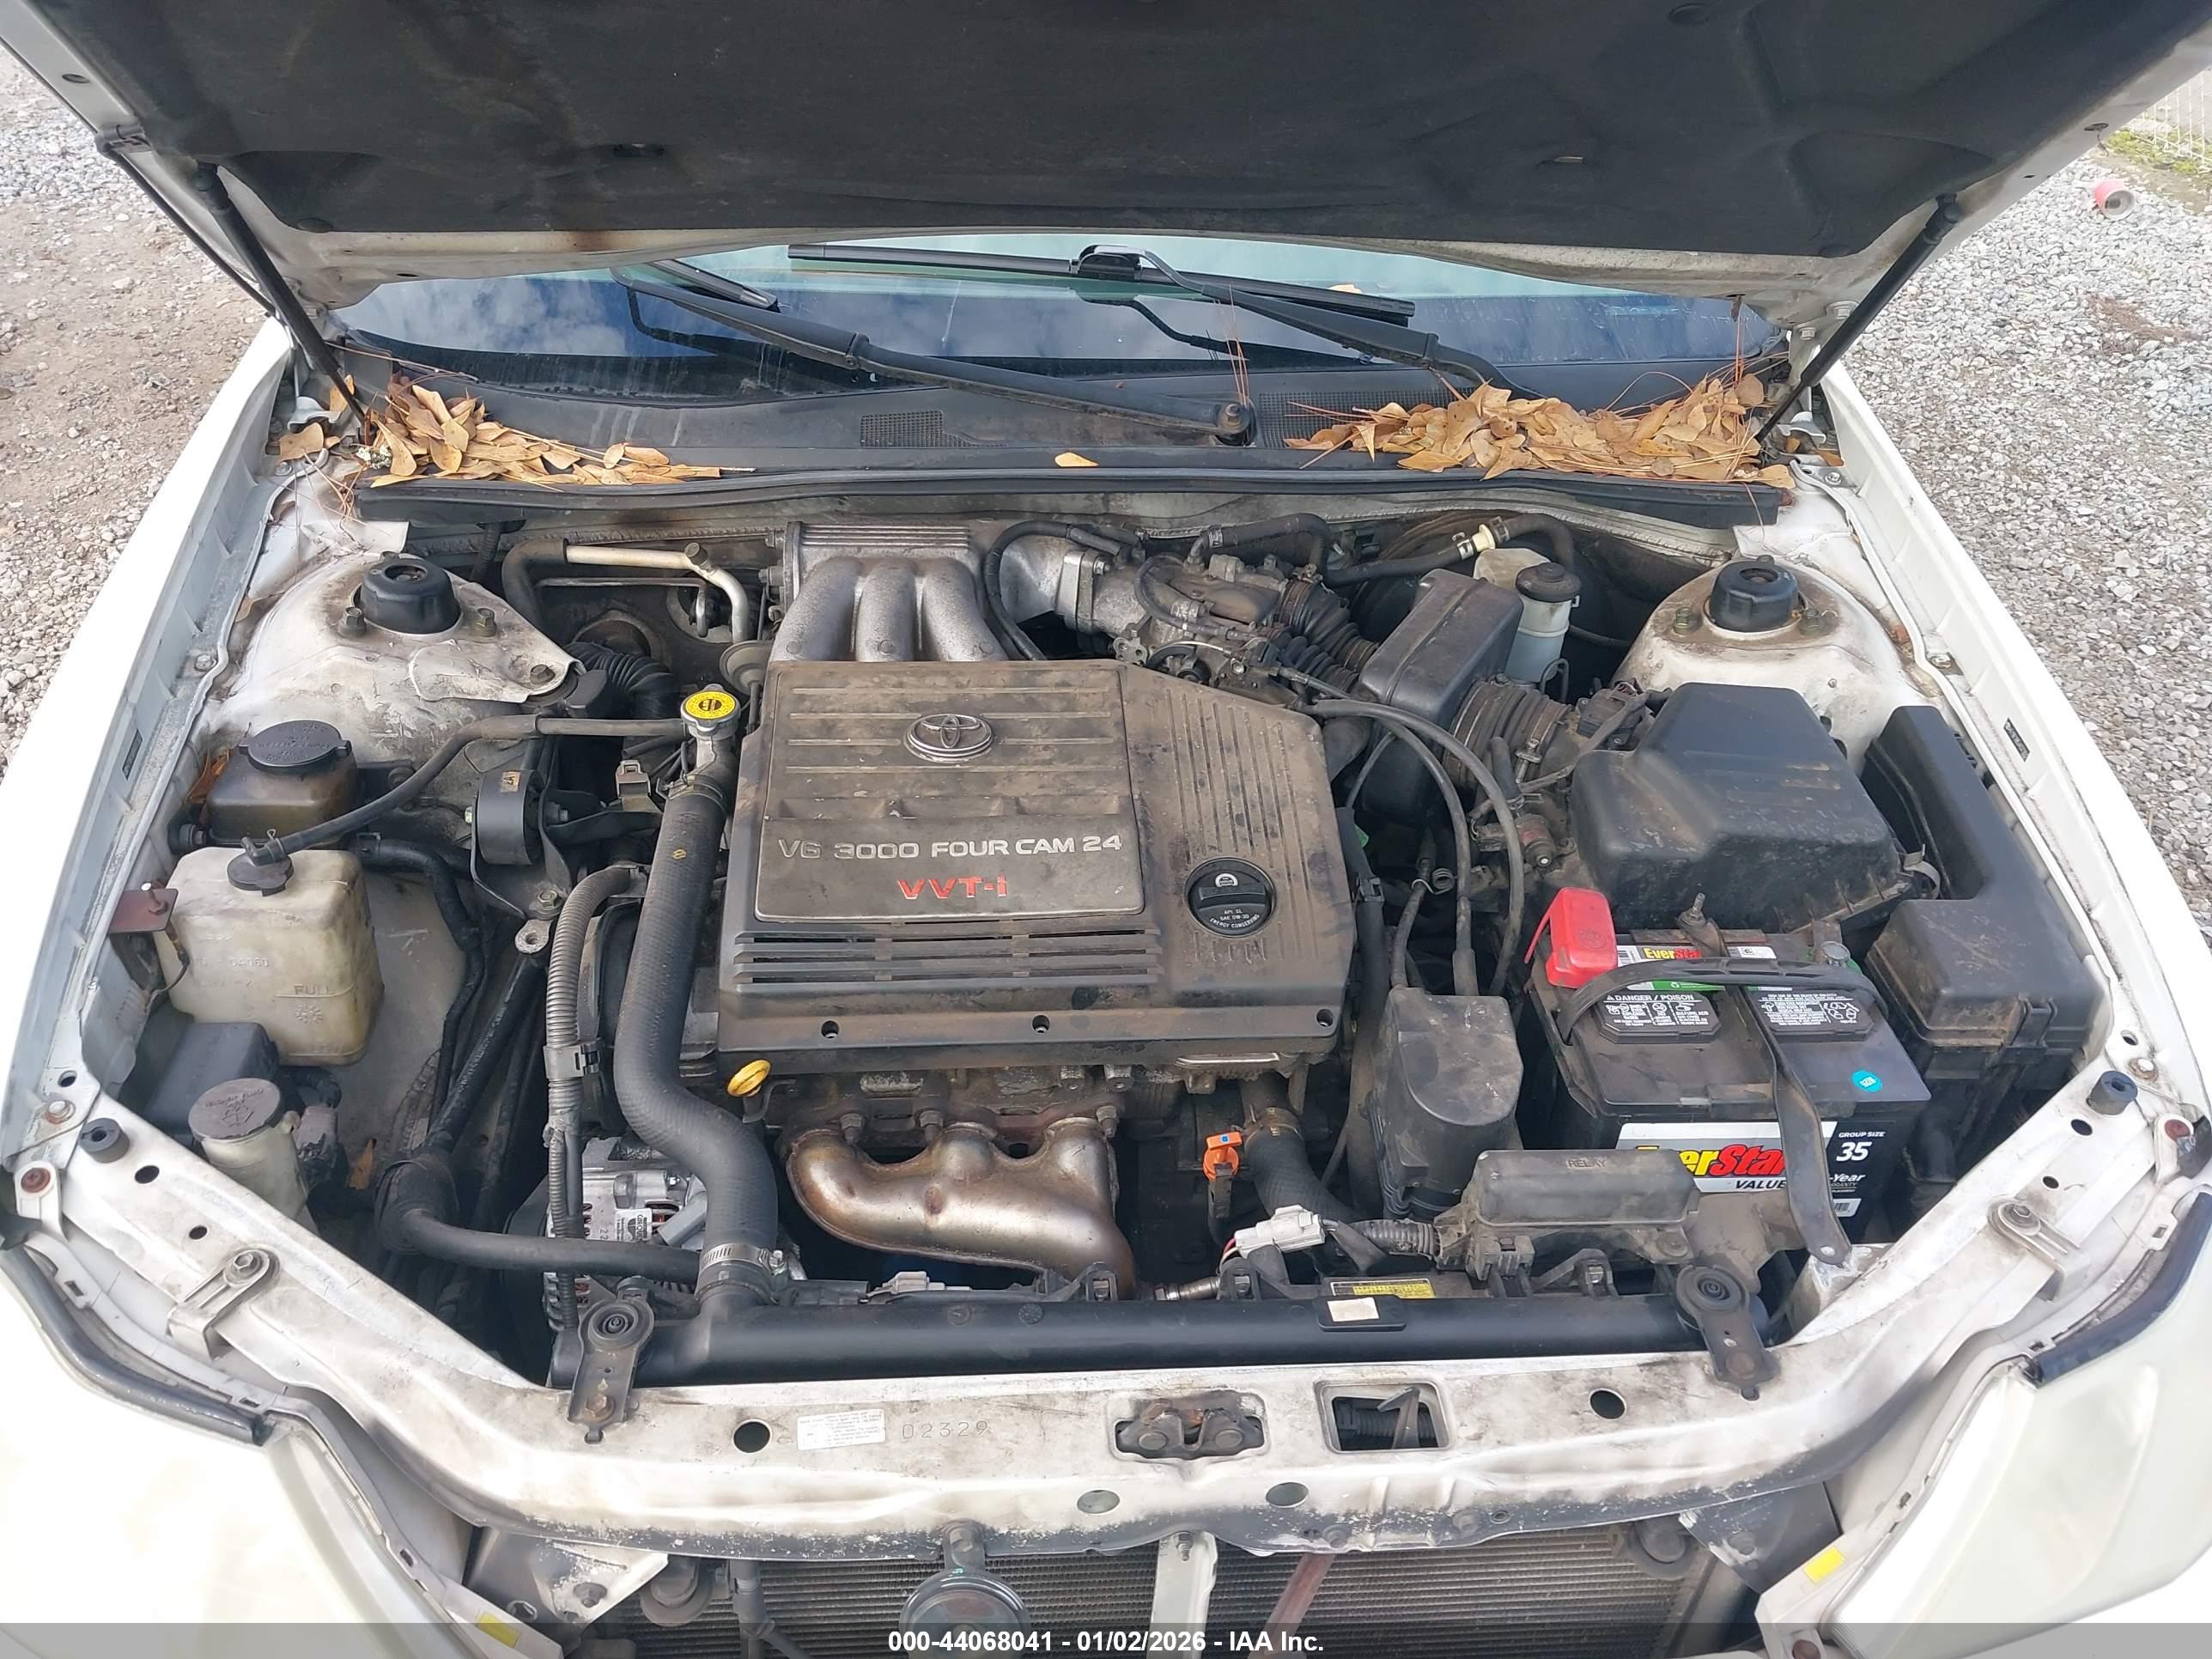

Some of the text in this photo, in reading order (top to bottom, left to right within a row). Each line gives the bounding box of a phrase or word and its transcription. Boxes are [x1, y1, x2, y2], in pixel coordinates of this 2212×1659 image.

[778, 835, 1123, 860] V6 3000 FOUR CAM 24
[896, 874, 1009, 900] VVT-i
[294, 984, 336, 995] FULL
[1836, 1141, 1873, 1162] 35
[1567, 1158, 1607, 1169] RELAY
[1735, 1179, 1786, 1190] VALUE
[902, 1420, 988, 1439] 02329
